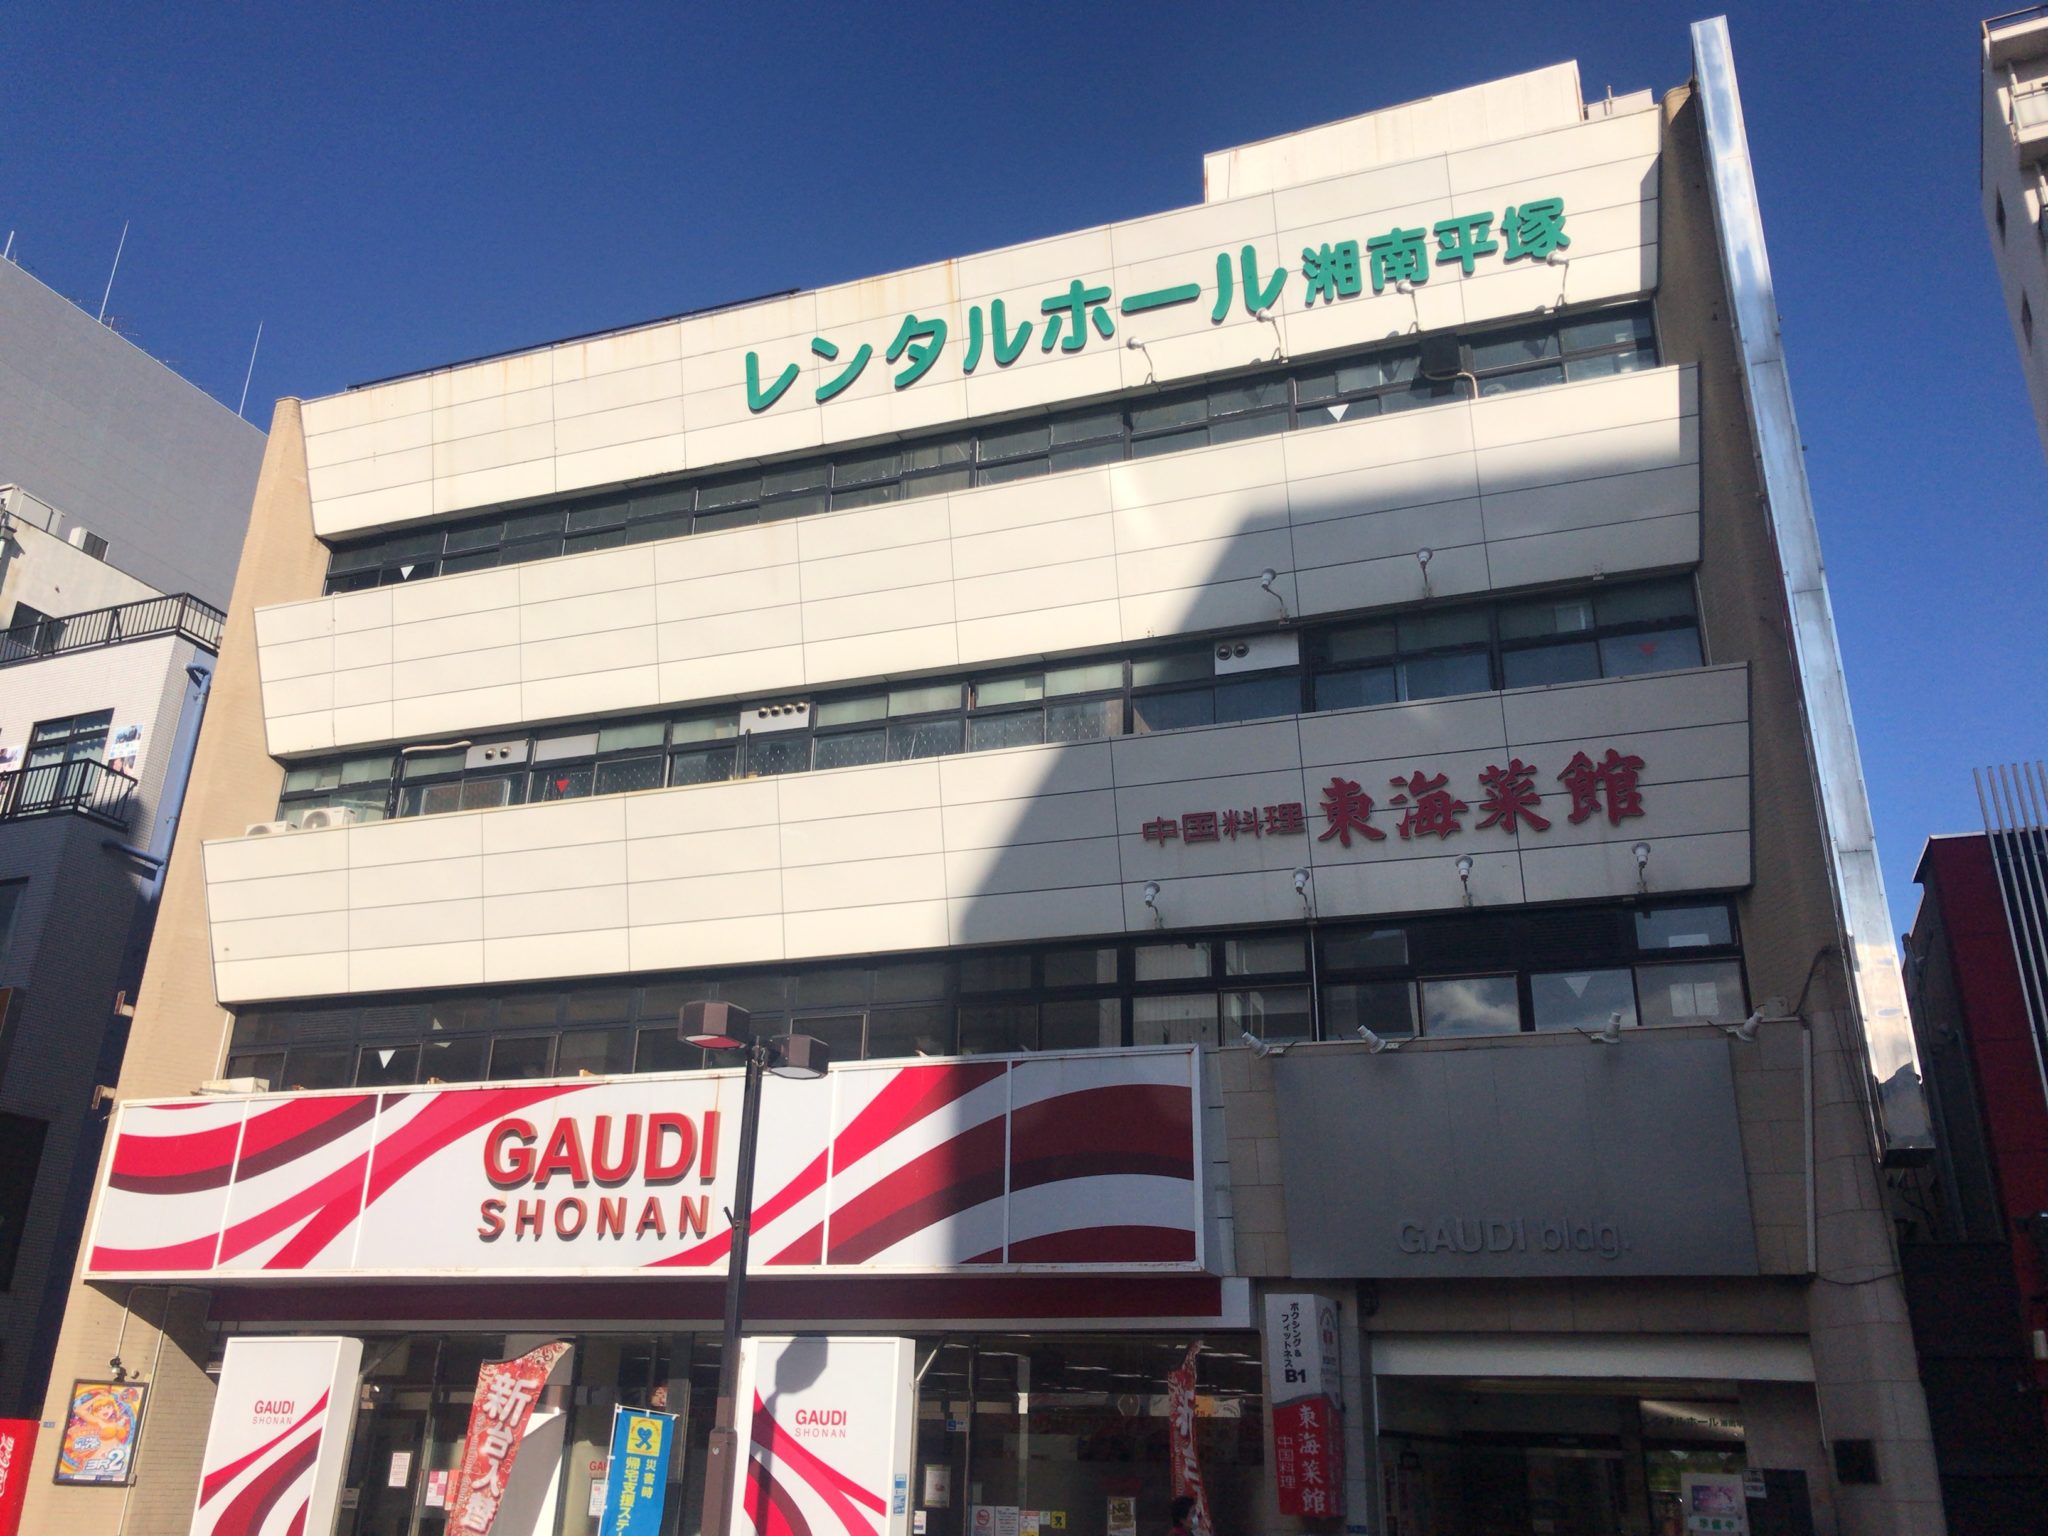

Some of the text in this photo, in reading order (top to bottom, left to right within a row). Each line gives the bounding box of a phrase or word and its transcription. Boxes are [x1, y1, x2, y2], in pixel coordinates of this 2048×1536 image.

[1142, 748, 1645, 847] 中国料理 東海菜館
[484, 1111, 721, 1186] GAUDI
[478, 1195, 709, 1239] SHONAN
[1399, 1217, 1630, 1259] GAUDI bldg.
[1281, 1314, 1294, 1368] フィットネス
[1284, 1369, 1306, 1383] B1
[252, 1416, 292, 1424] SHONAN
[254, 1400, 294, 1414] GAUDI
[795, 1409, 846, 1425] GAUDI
[460, 1372, 538, 1532] 新台入替
[794, 1427, 846, 1438] SHONAN
[1278, 1436, 1296, 1489] 中国料理
[1299, 1404, 1326, 1513] 東海菜館
